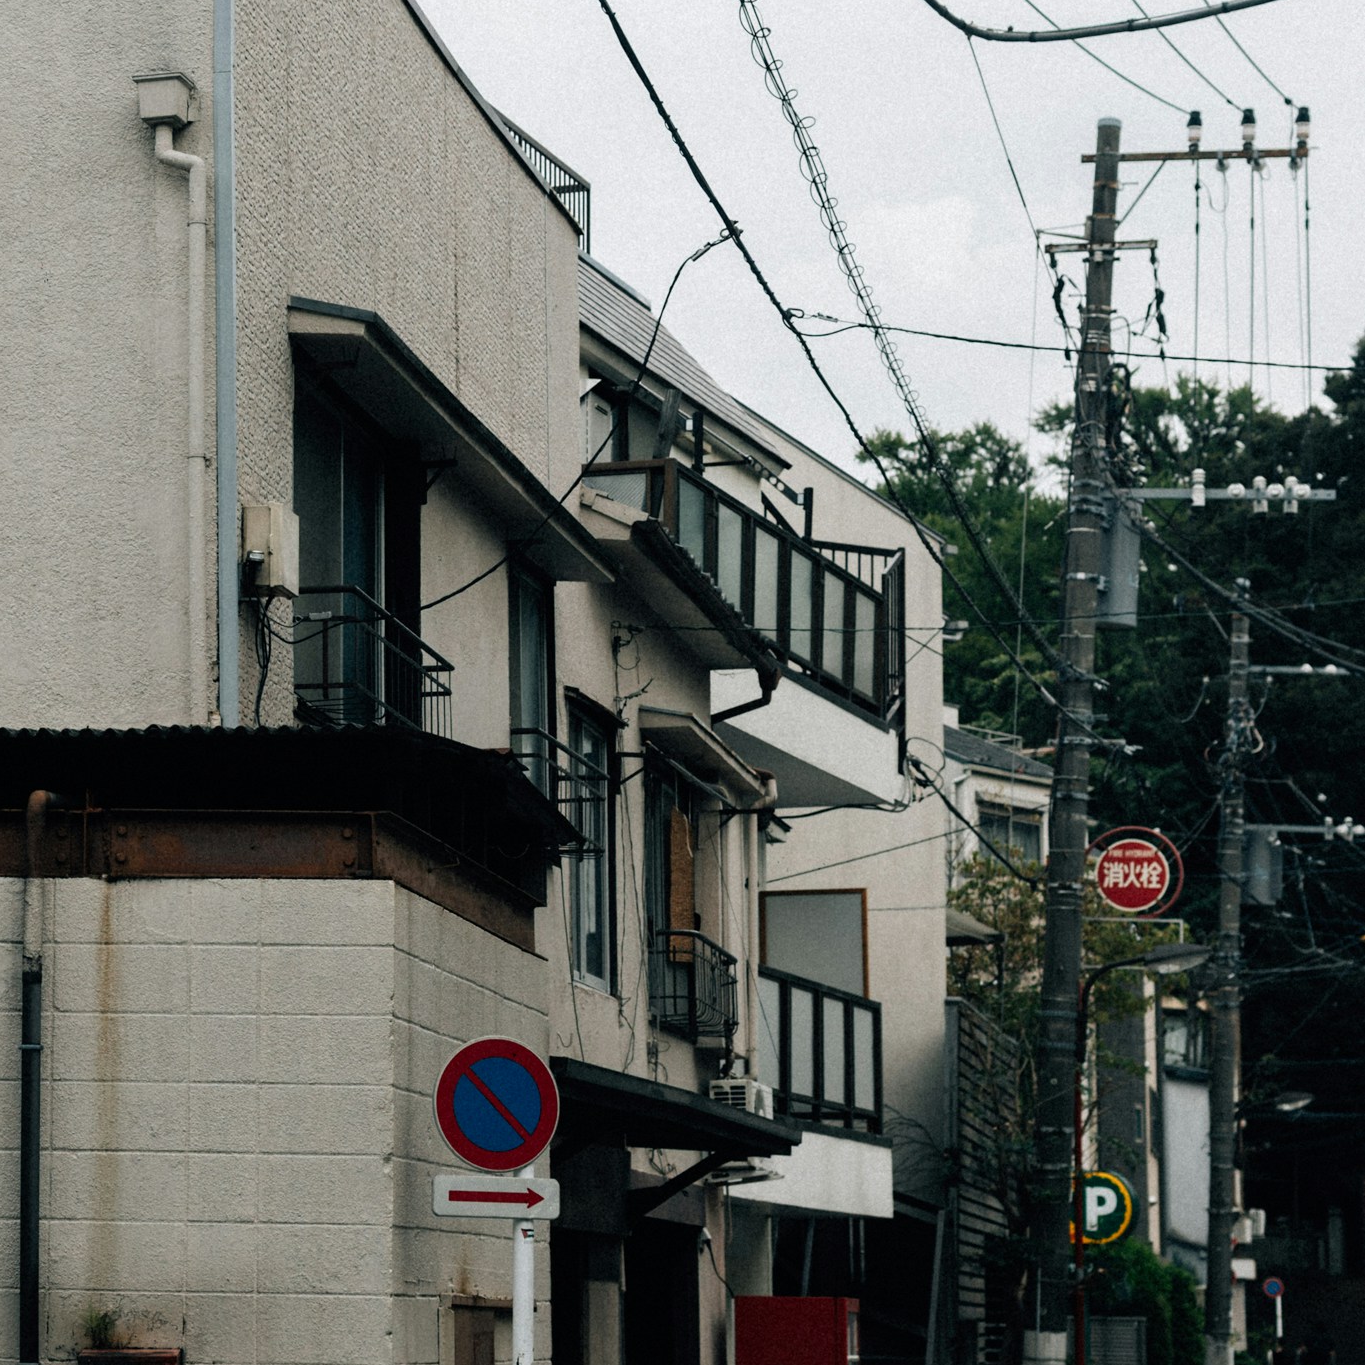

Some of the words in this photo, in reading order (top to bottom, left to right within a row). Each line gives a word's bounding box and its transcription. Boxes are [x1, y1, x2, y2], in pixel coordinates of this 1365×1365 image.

[1108, 849, 1123, 858] FIRE
[1103, 861, 1163, 889] 消火栓
[1085, 1186, 1118, 1232] P
